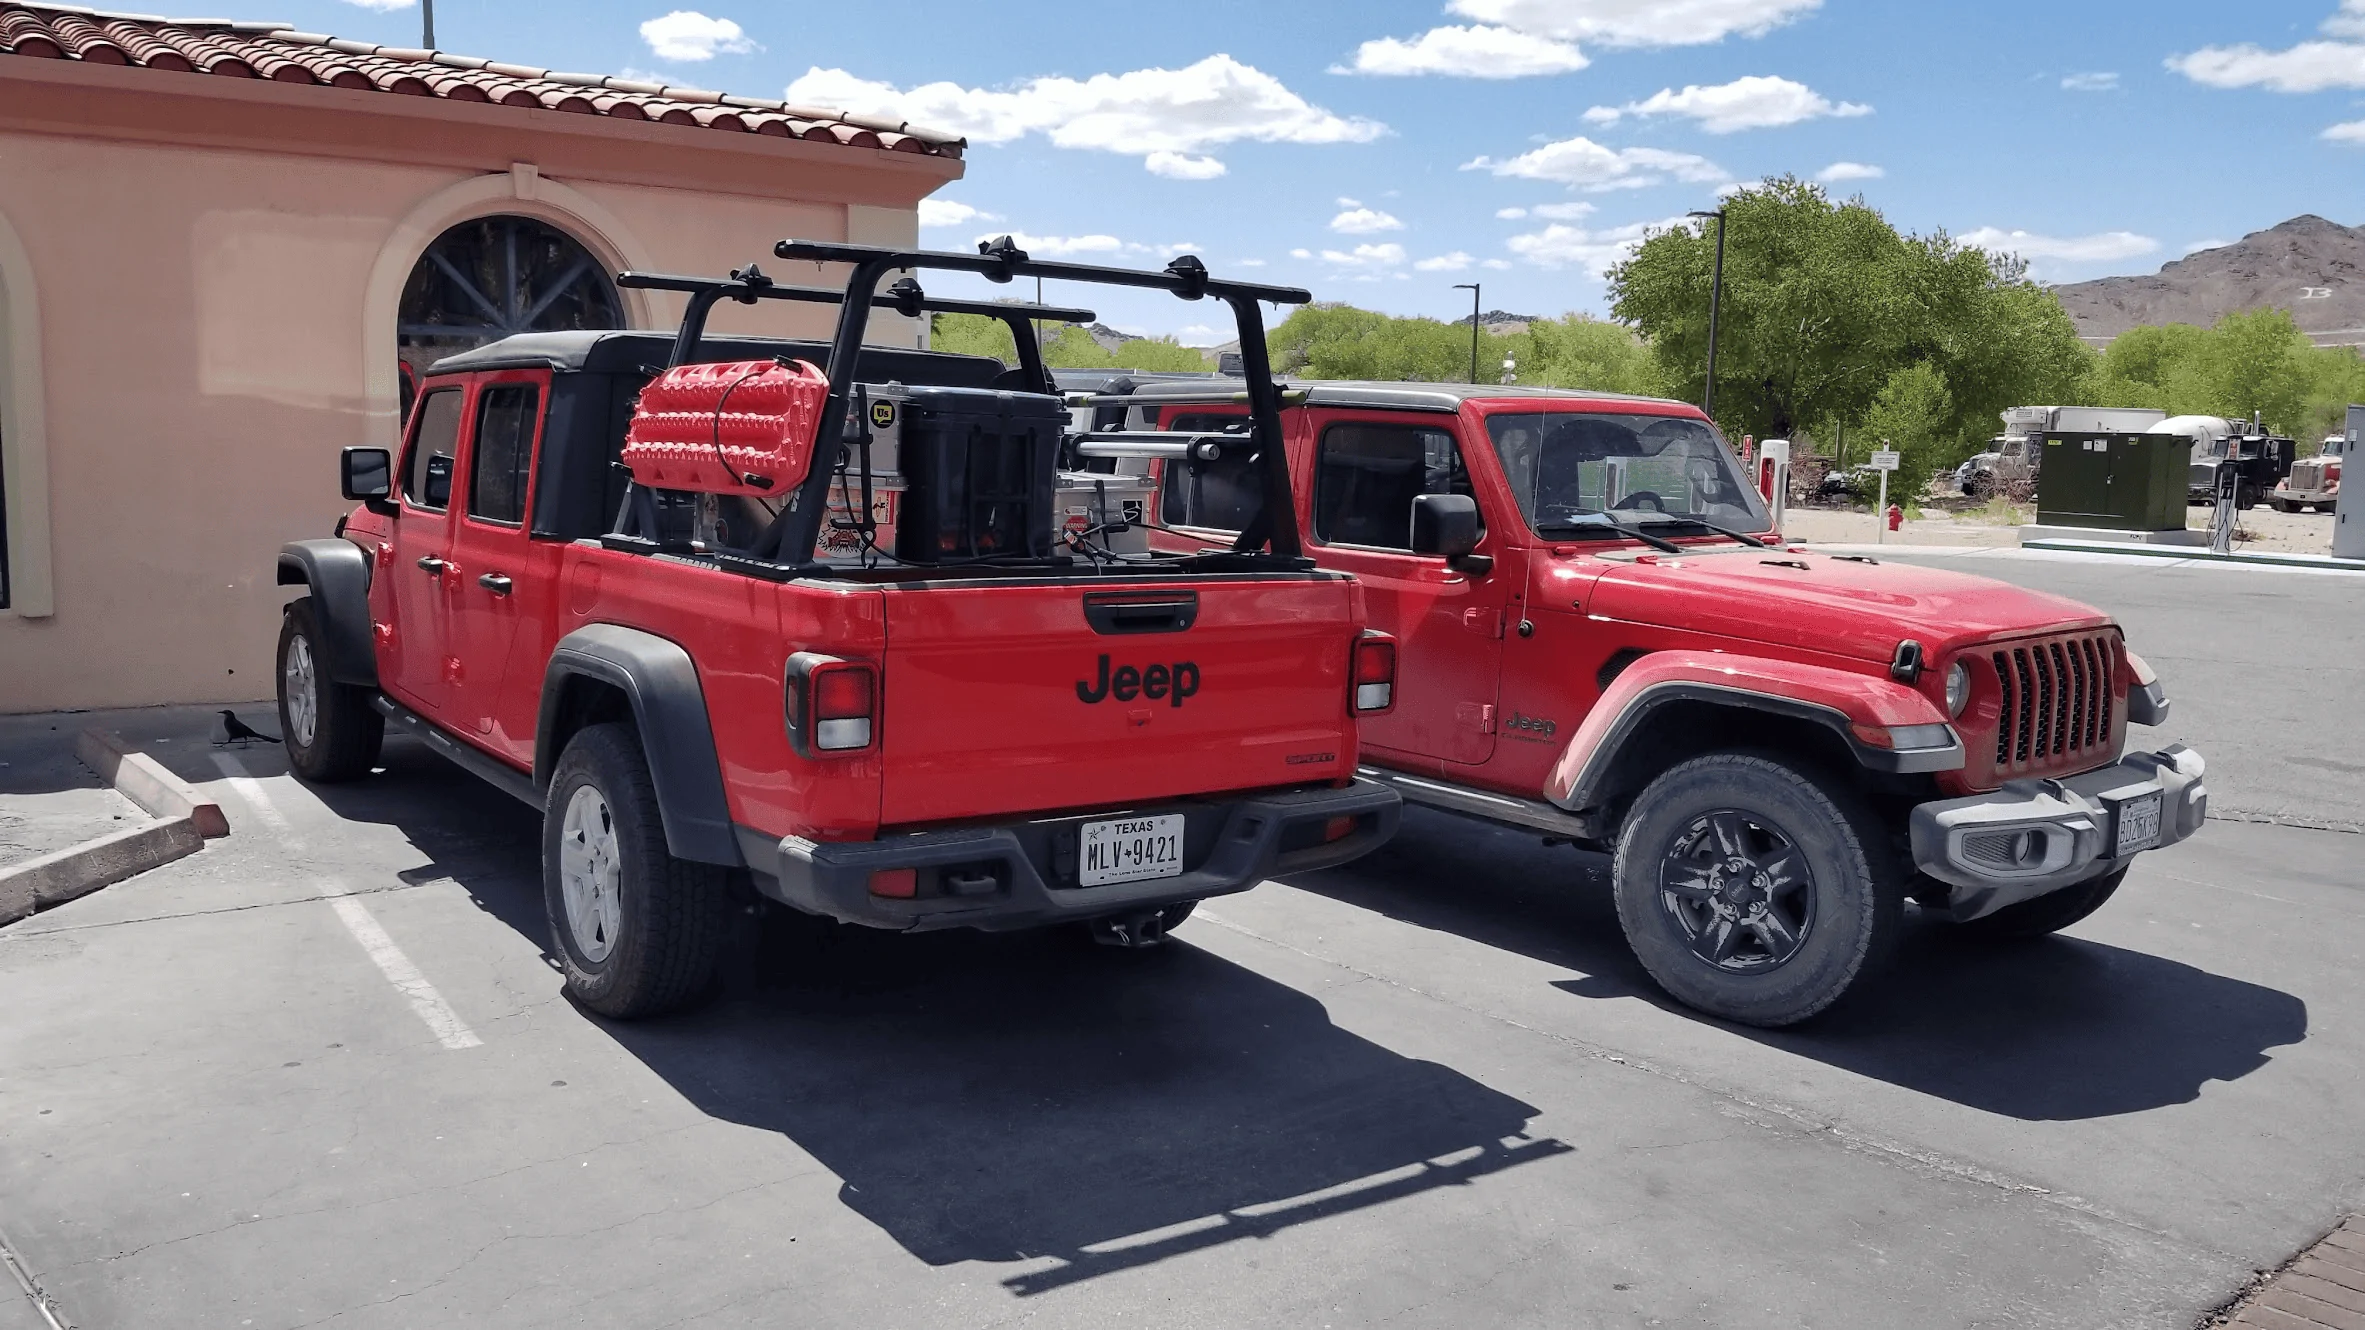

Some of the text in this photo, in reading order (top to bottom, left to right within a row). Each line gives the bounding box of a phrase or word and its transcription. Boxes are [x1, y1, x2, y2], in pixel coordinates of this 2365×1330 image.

[876, 407, 889, 418] Us
[1075, 653, 1201, 708] Jeep
[1506, 712, 1556, 738] Jeep
[1115, 820, 1154, 835] TEXAS
